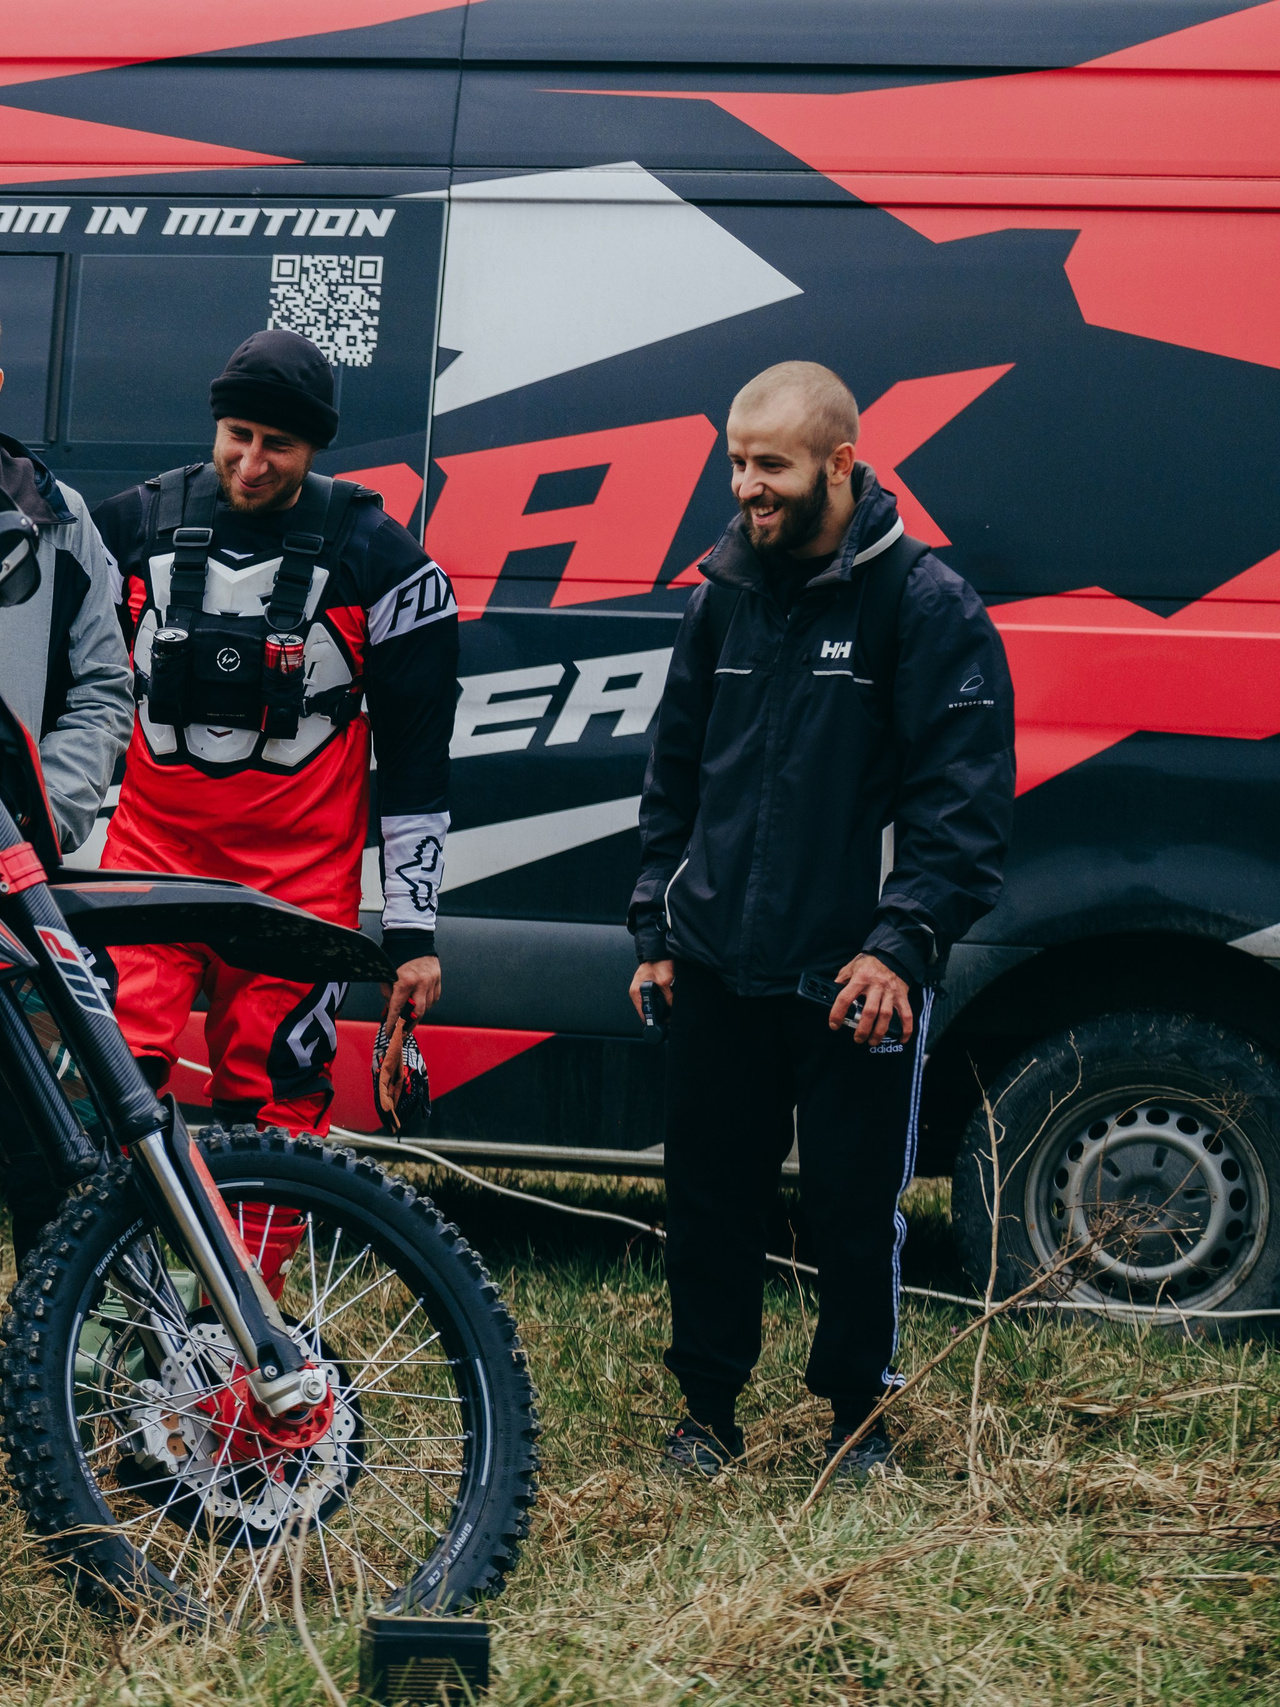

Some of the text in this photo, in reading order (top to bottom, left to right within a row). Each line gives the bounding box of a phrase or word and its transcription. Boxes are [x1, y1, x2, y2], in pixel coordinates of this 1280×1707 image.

[84, 206, 148, 235] IN
[161, 207, 396, 237] MOTION
[820, 640, 853, 659] HH
[869, 1044, 904, 1054] adidas
[95, 1218, 144, 1277] GIANT RACE
[427, 1522, 473, 1587] GIANT RCE
